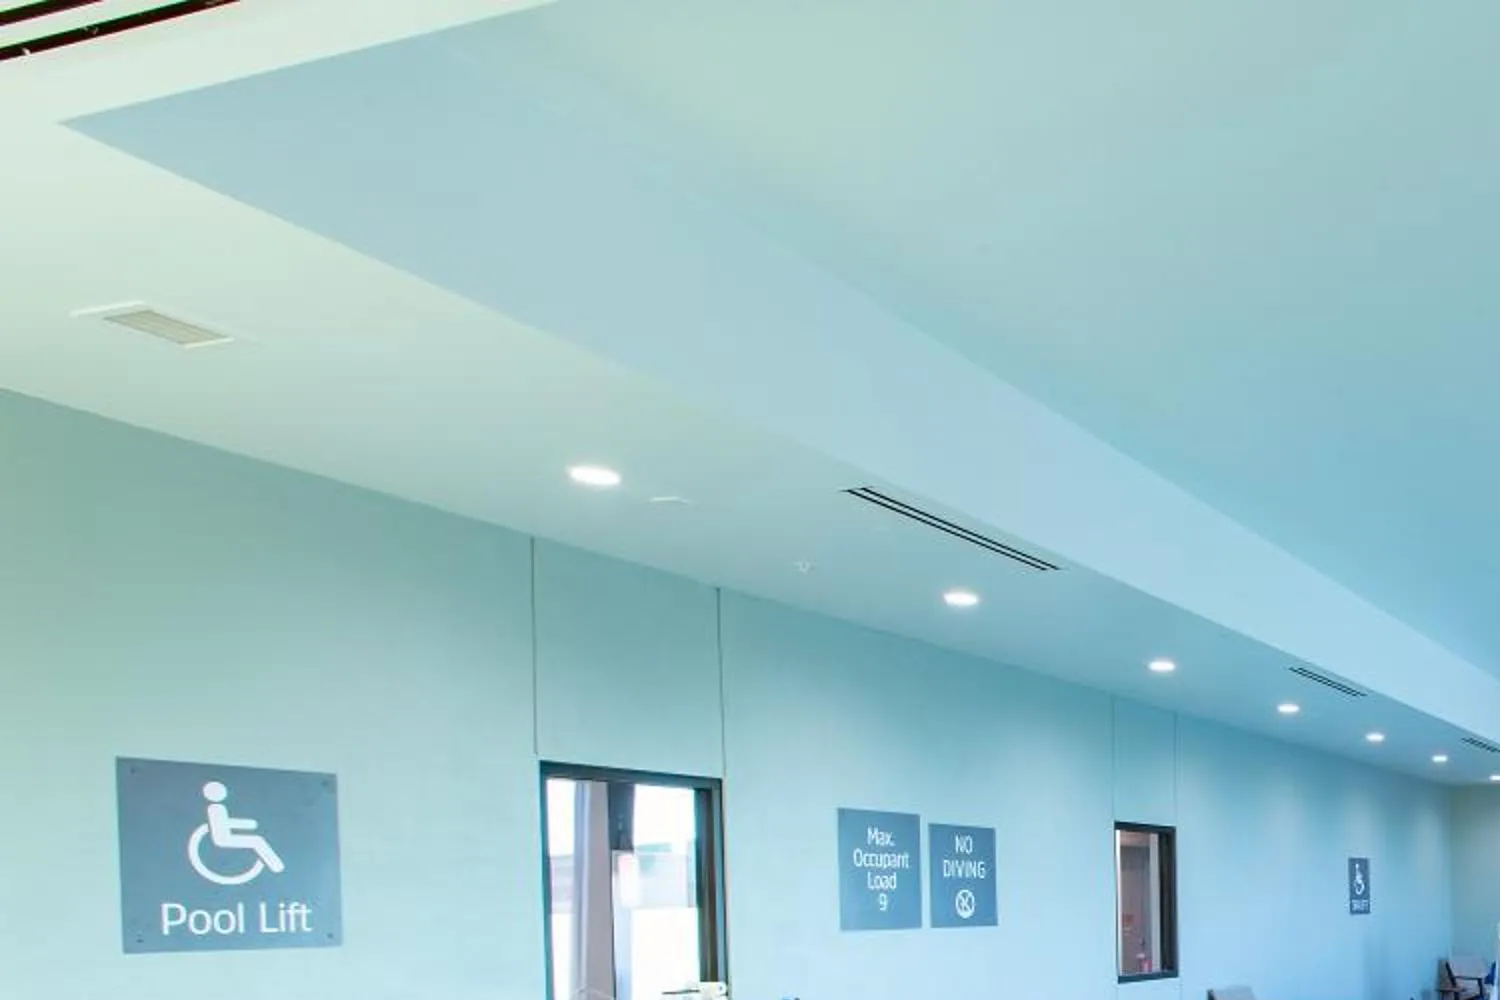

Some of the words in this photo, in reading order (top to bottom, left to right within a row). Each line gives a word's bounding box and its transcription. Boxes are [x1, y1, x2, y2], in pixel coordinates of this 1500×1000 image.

[867, 827, 895, 846] Max.
[954, 834, 973, 855] NO
[852, 848, 910, 869] Occupant
[942, 859, 986, 879] DIVING
[866, 872, 897, 890] Load
[160, 902, 246, 936] Pool
[259, 901, 314, 934] Lift
